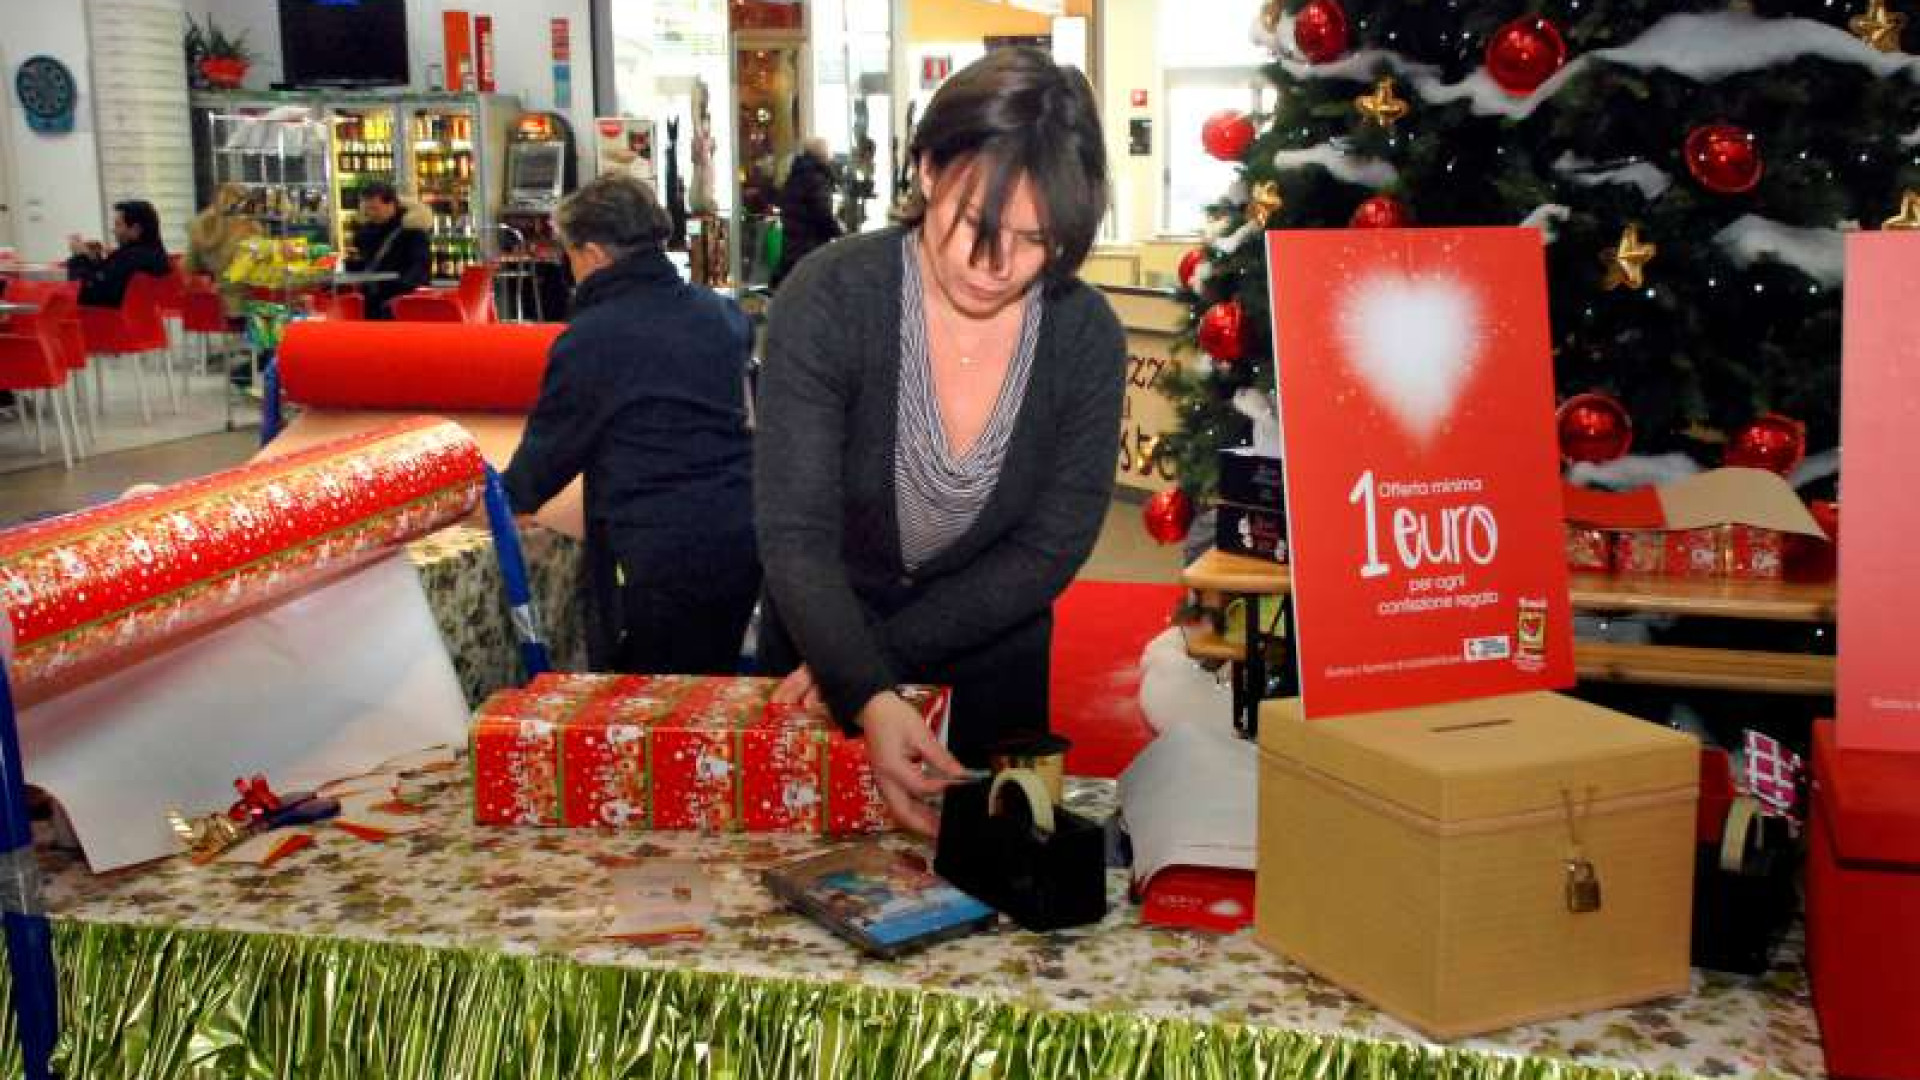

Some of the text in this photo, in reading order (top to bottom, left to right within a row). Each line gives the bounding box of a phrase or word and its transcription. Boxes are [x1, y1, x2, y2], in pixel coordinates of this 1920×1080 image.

[1379, 478, 1482, 497] Offerta minima
[1349, 469, 1498, 578] 1 euro
[1408, 573, 1465, 592] per ogni
[1378, 597, 1453, 616] confezione
[1456, 592, 1499, 608] regalo
